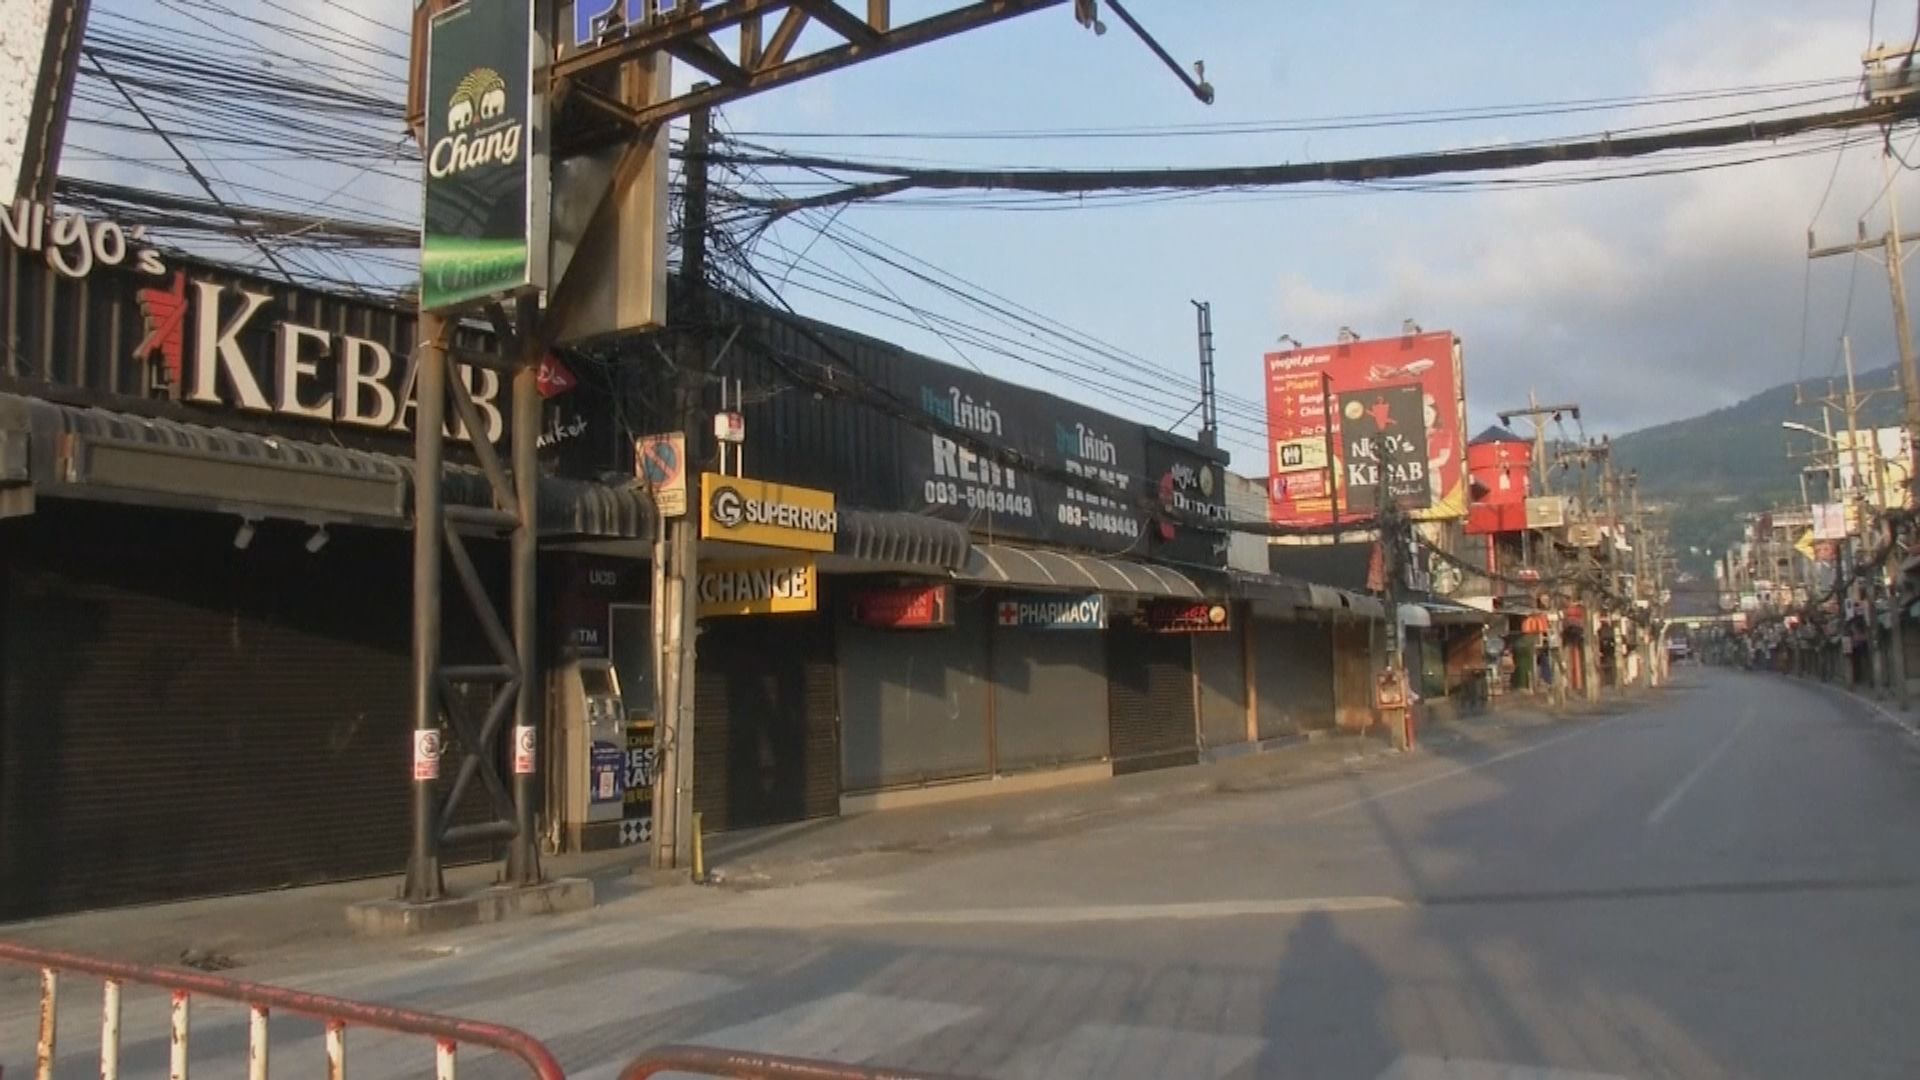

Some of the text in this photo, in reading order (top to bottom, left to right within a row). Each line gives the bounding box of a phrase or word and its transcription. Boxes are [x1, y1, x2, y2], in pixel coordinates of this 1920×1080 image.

[429, 122, 523, 179] Chang
[1347, 461, 1424, 487] KEAB
[1020, 600, 1100, 624] PHARMACY
[572, 628, 599, 643] TM
